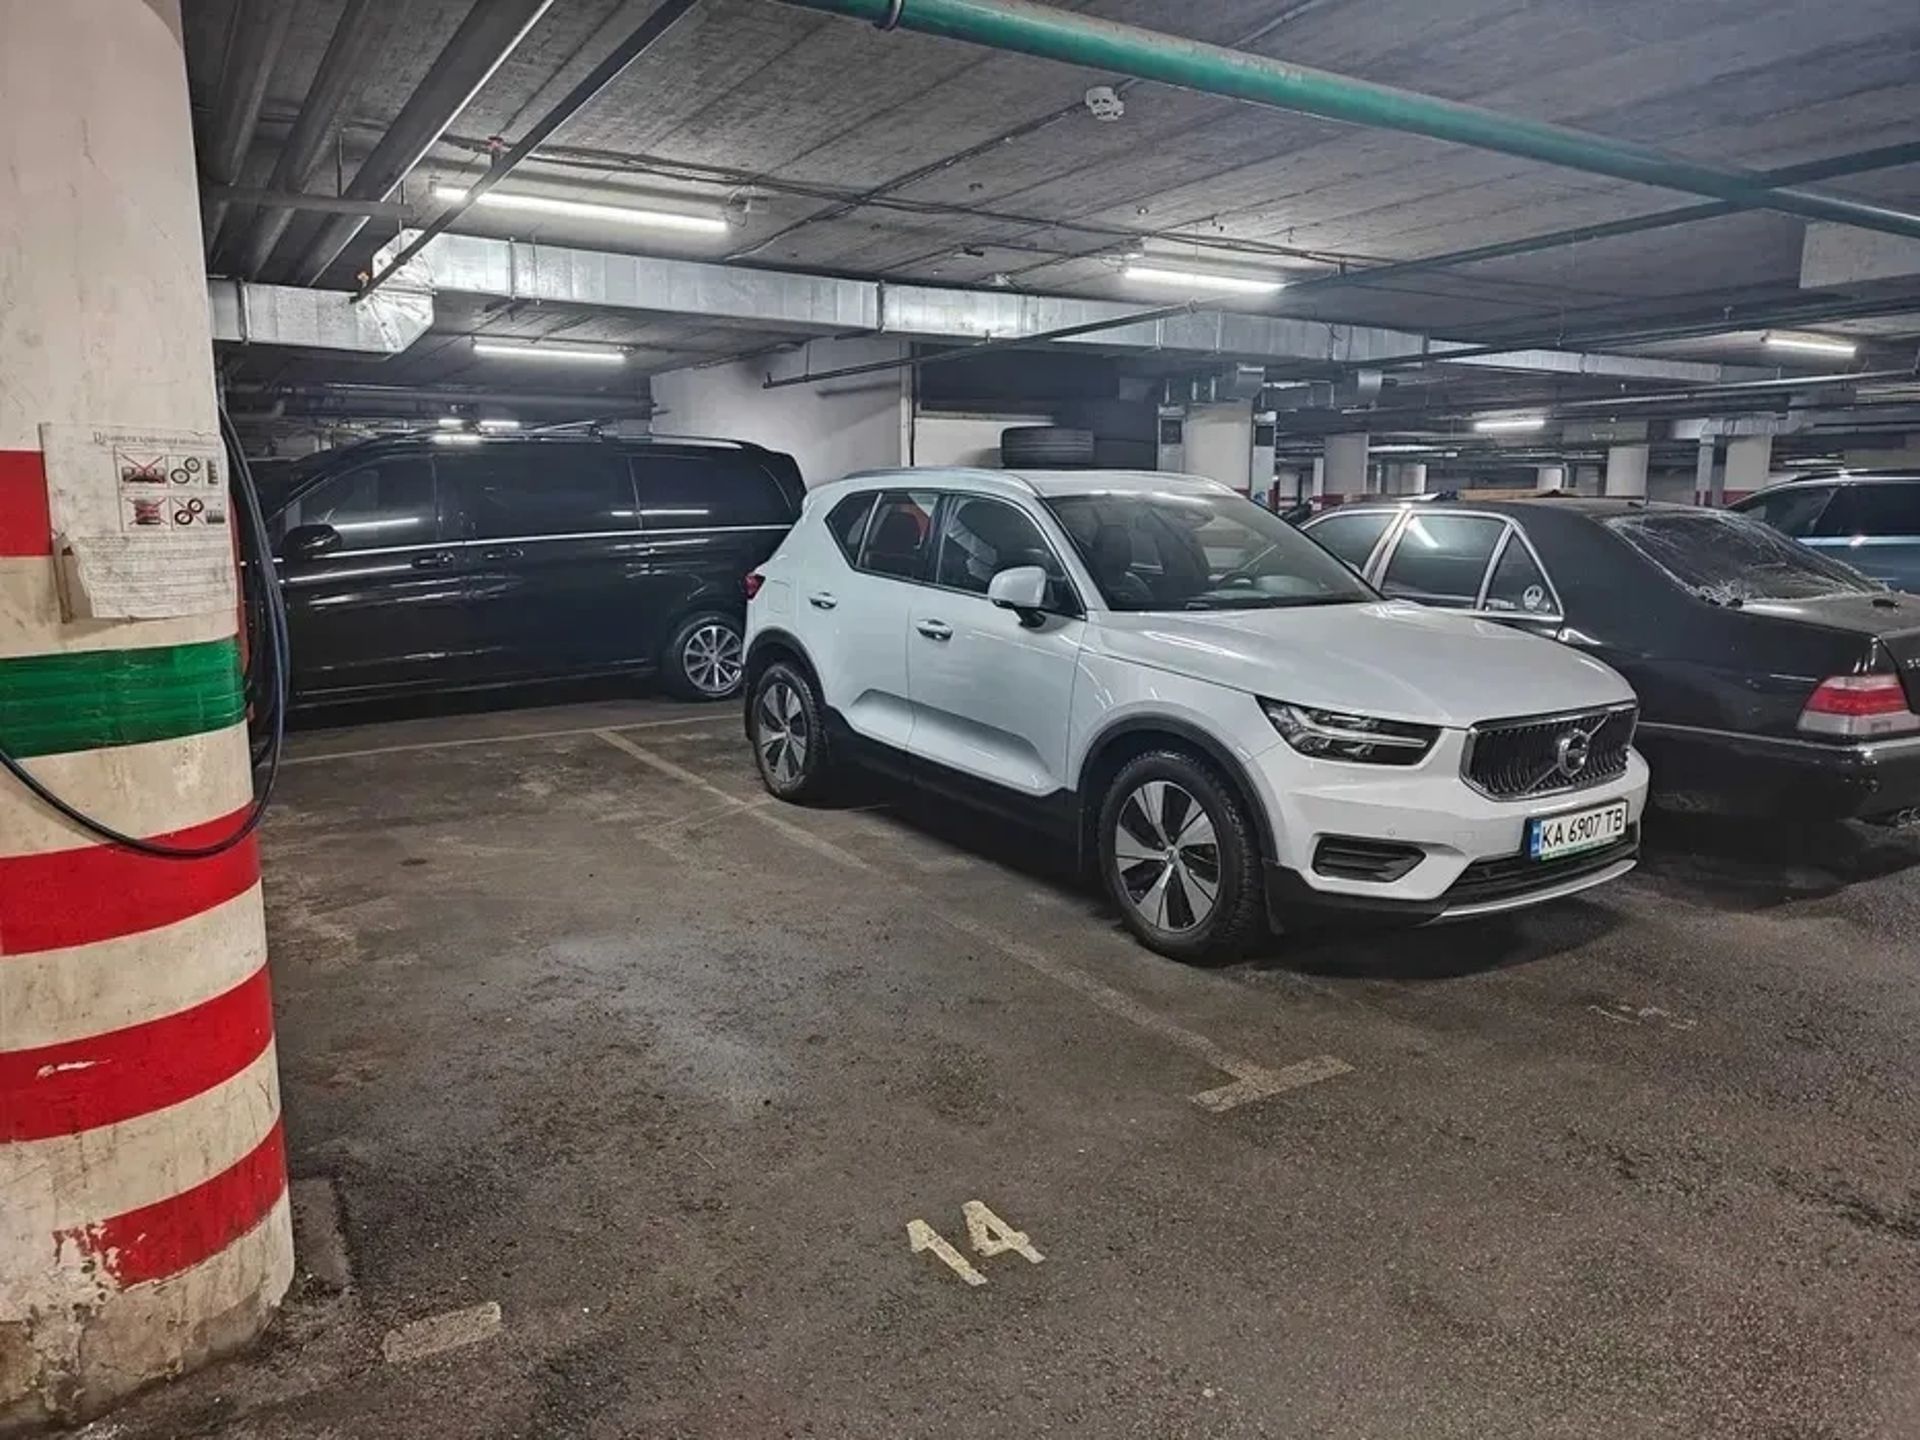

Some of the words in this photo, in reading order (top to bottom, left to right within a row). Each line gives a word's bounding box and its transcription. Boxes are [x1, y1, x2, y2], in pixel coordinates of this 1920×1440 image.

[1542, 822, 1564, 848] KA
[1568, 813, 1602, 842] 6907
[1605, 808, 1623, 833] TB
[906, 1199, 1046, 1287] 14
